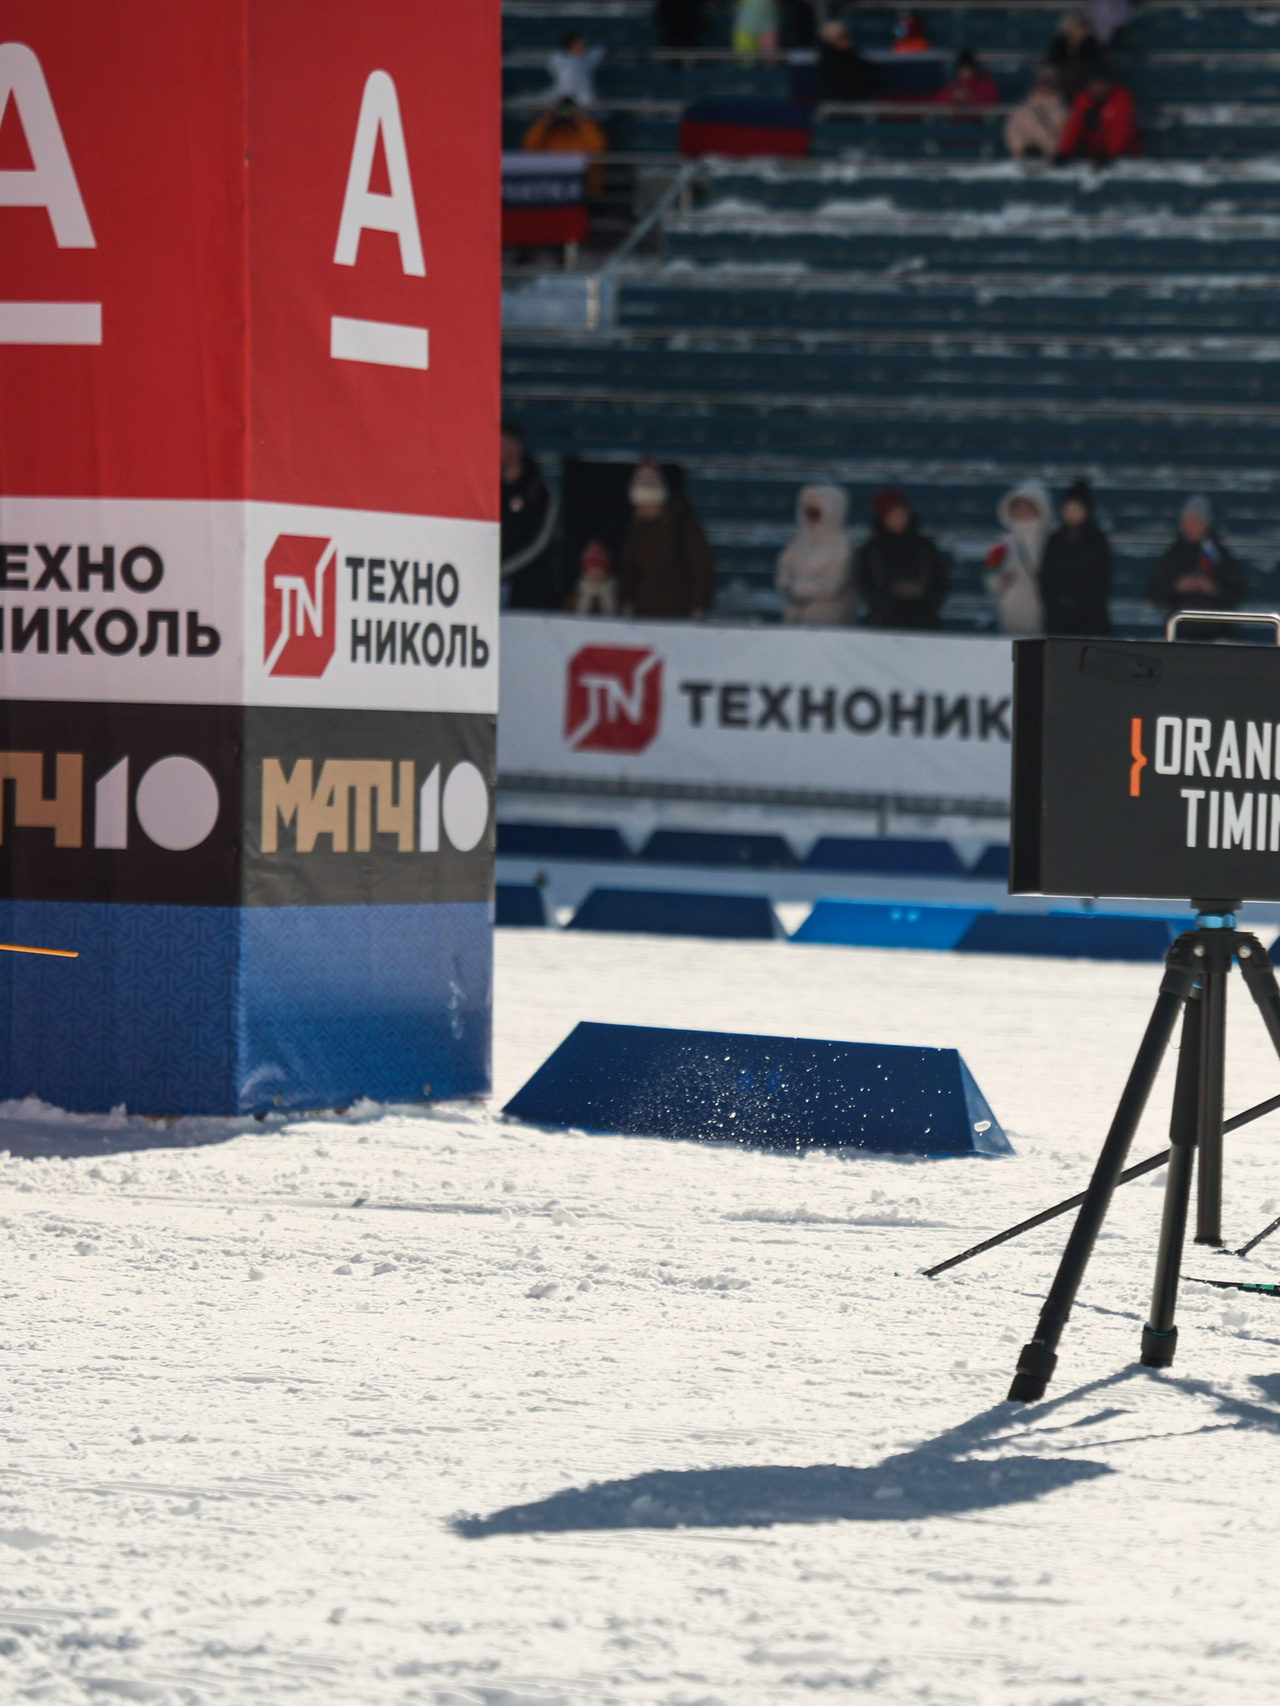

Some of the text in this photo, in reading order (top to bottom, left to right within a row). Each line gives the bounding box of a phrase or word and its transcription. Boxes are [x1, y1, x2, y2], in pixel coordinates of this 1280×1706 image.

[333, 69, 426, 278] А
[345, 556, 459, 607] ТЕХНО
[0, 607, 222, 658] ИКОЛЬ
[350, 619, 490, 669] НИКОЛЬ
